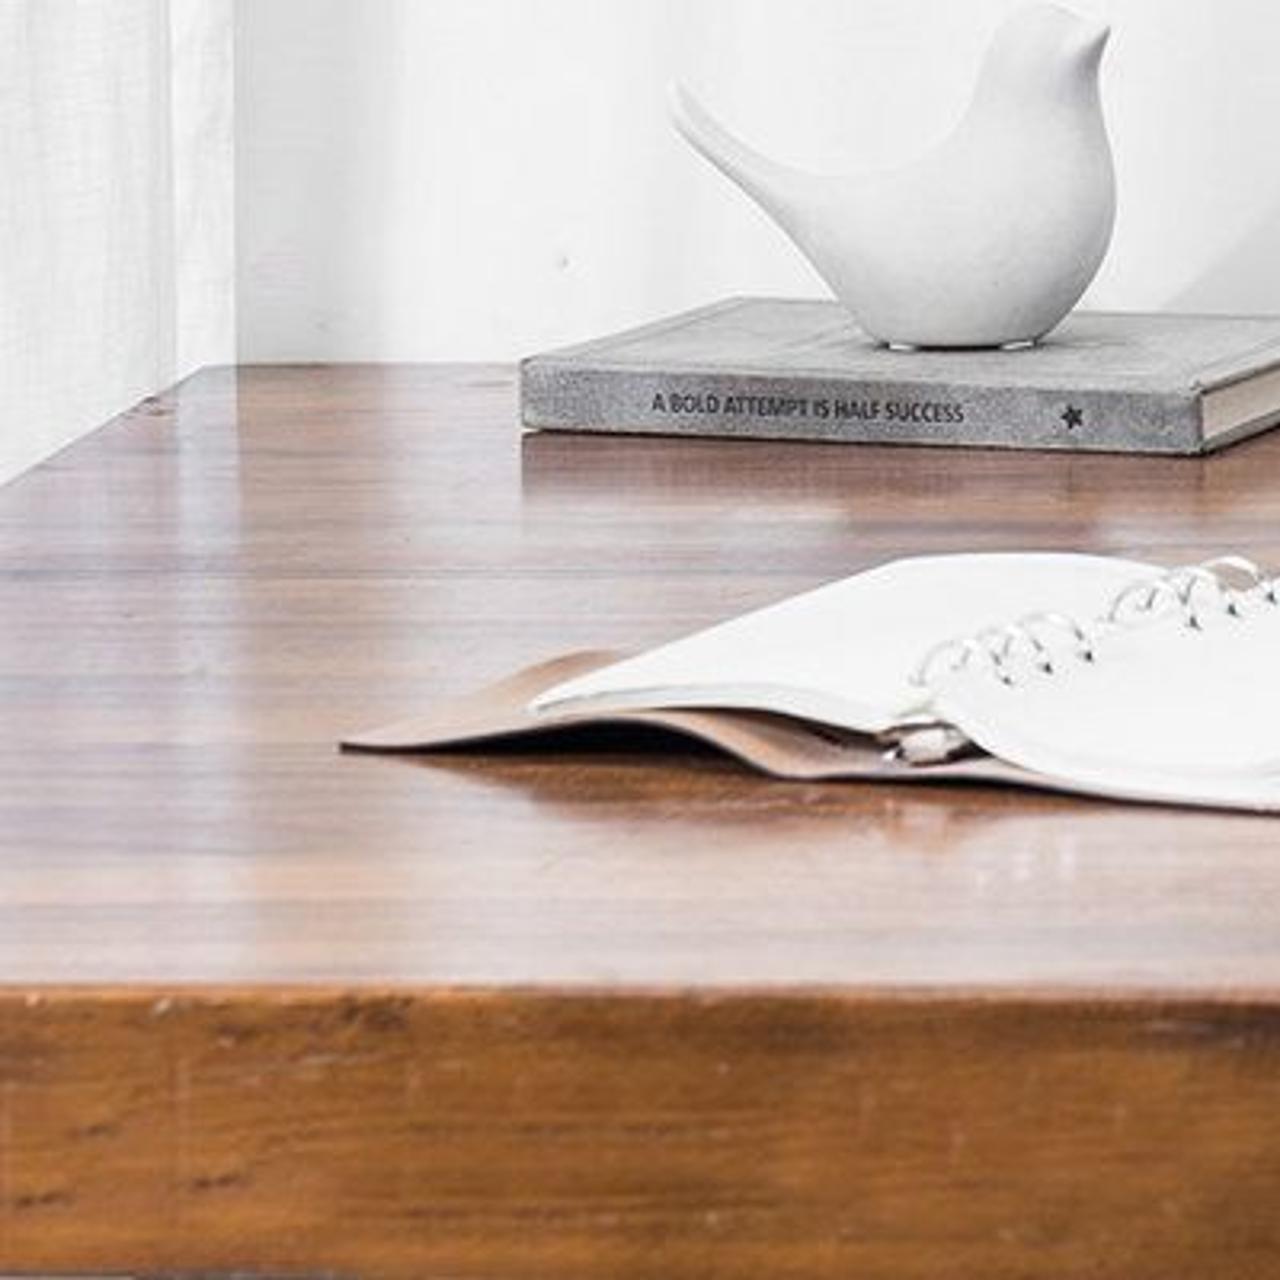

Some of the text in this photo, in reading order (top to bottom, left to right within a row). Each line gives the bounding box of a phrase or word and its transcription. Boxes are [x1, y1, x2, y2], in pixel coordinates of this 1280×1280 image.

[652, 393, 965, 423] A BOLD ATTEMPT IS HALF SUCCESS
